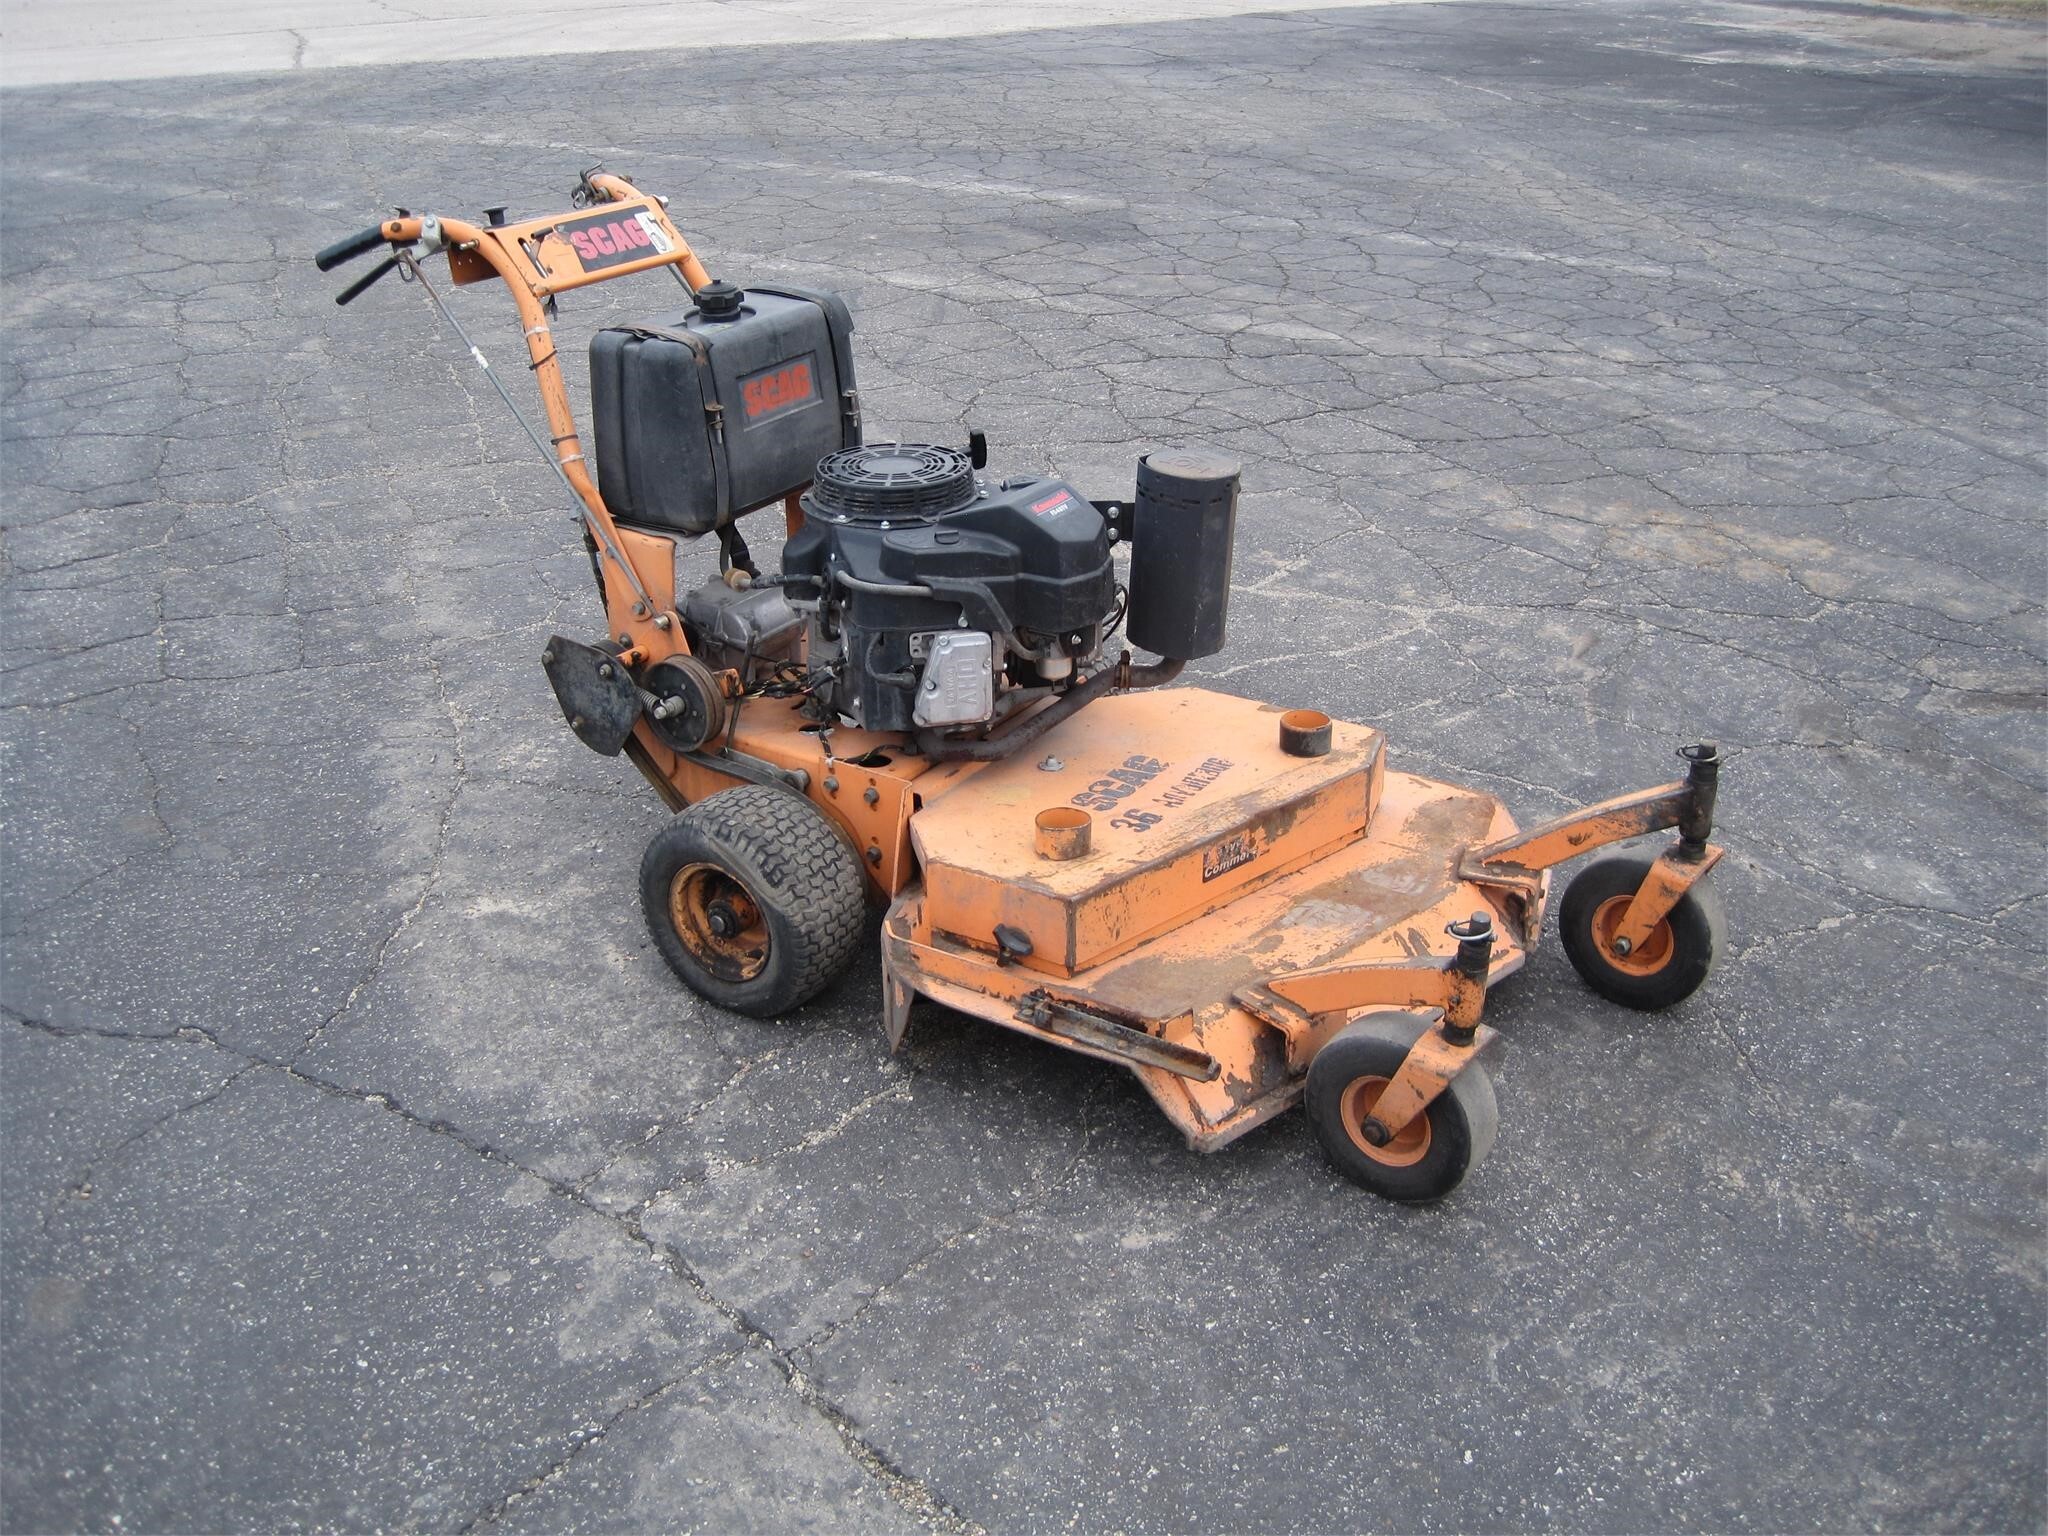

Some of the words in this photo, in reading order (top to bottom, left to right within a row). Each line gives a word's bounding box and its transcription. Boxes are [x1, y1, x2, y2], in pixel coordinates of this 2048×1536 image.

[570, 218, 651, 259] SCAG
[743, 363, 810, 416] SCAG
[1071, 755, 1169, 812] SCAG
[1110, 808, 1163, 833] 36
